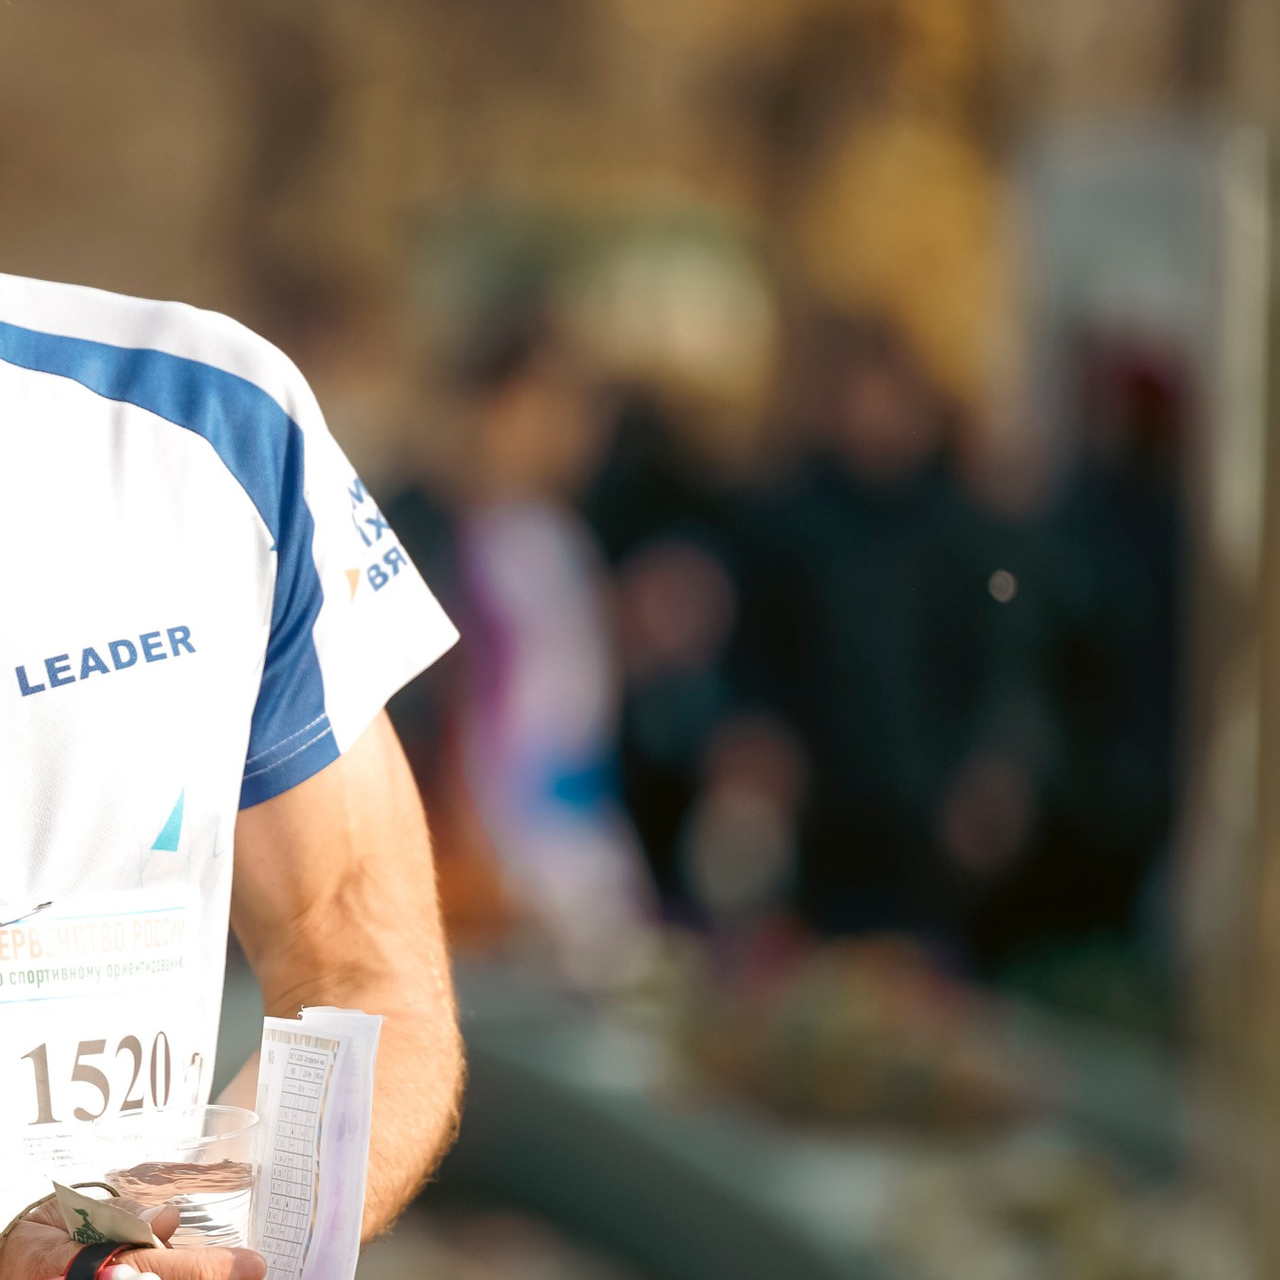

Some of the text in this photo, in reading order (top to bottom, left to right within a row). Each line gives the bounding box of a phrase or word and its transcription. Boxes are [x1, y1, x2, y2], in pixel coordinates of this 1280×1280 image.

[15, 625, 197, 697] LEADER
[9, 965, 101, 988] спортивному
[20, 1030, 171, 1125] 1520
